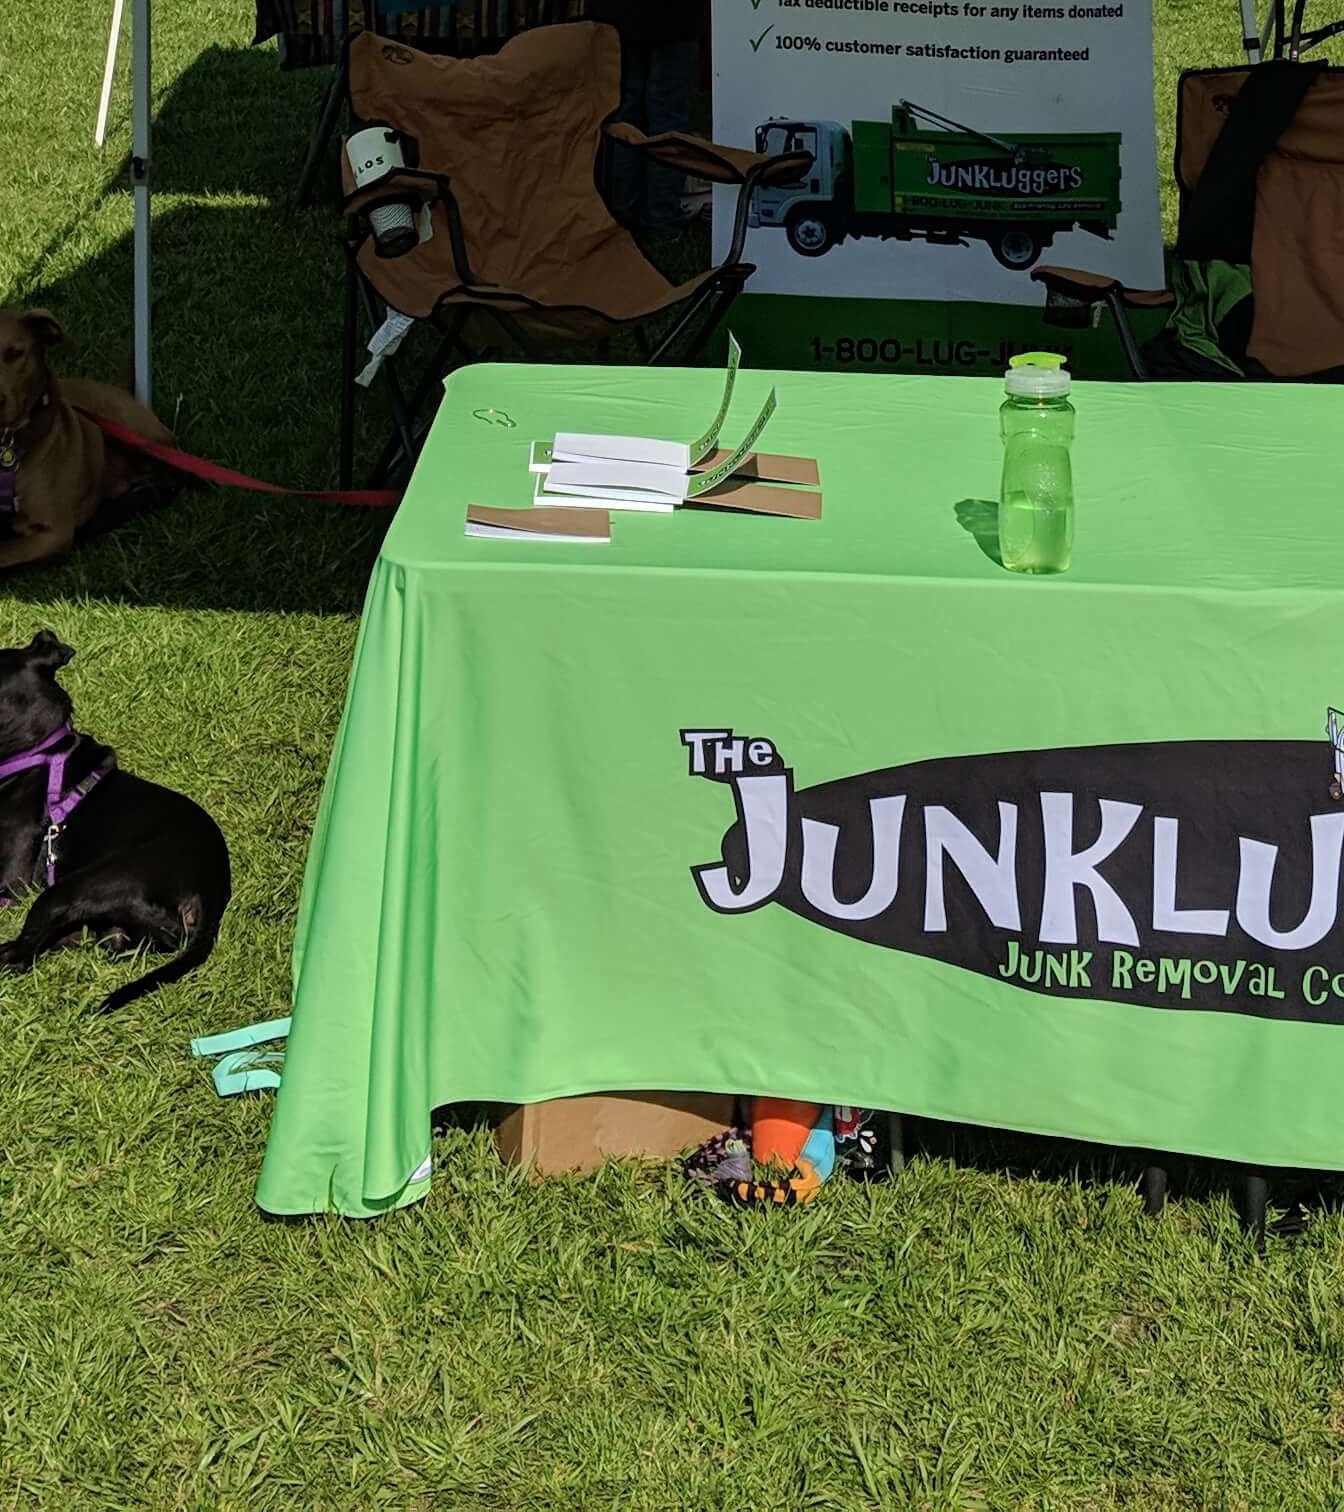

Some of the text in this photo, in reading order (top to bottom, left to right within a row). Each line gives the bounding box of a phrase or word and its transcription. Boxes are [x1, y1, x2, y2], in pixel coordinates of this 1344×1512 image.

[893, 0, 958, 18] receipts
[963, 1, 987, 16] for
[990, 4, 1018, 21] any
[1023, 2, 1065, 19] items
[1068, 3, 1123, 19] donated
[775, 35, 1089, 64] 100% customer satisfaction guaranteed
[999, 941, 1094, 987] JUNK
